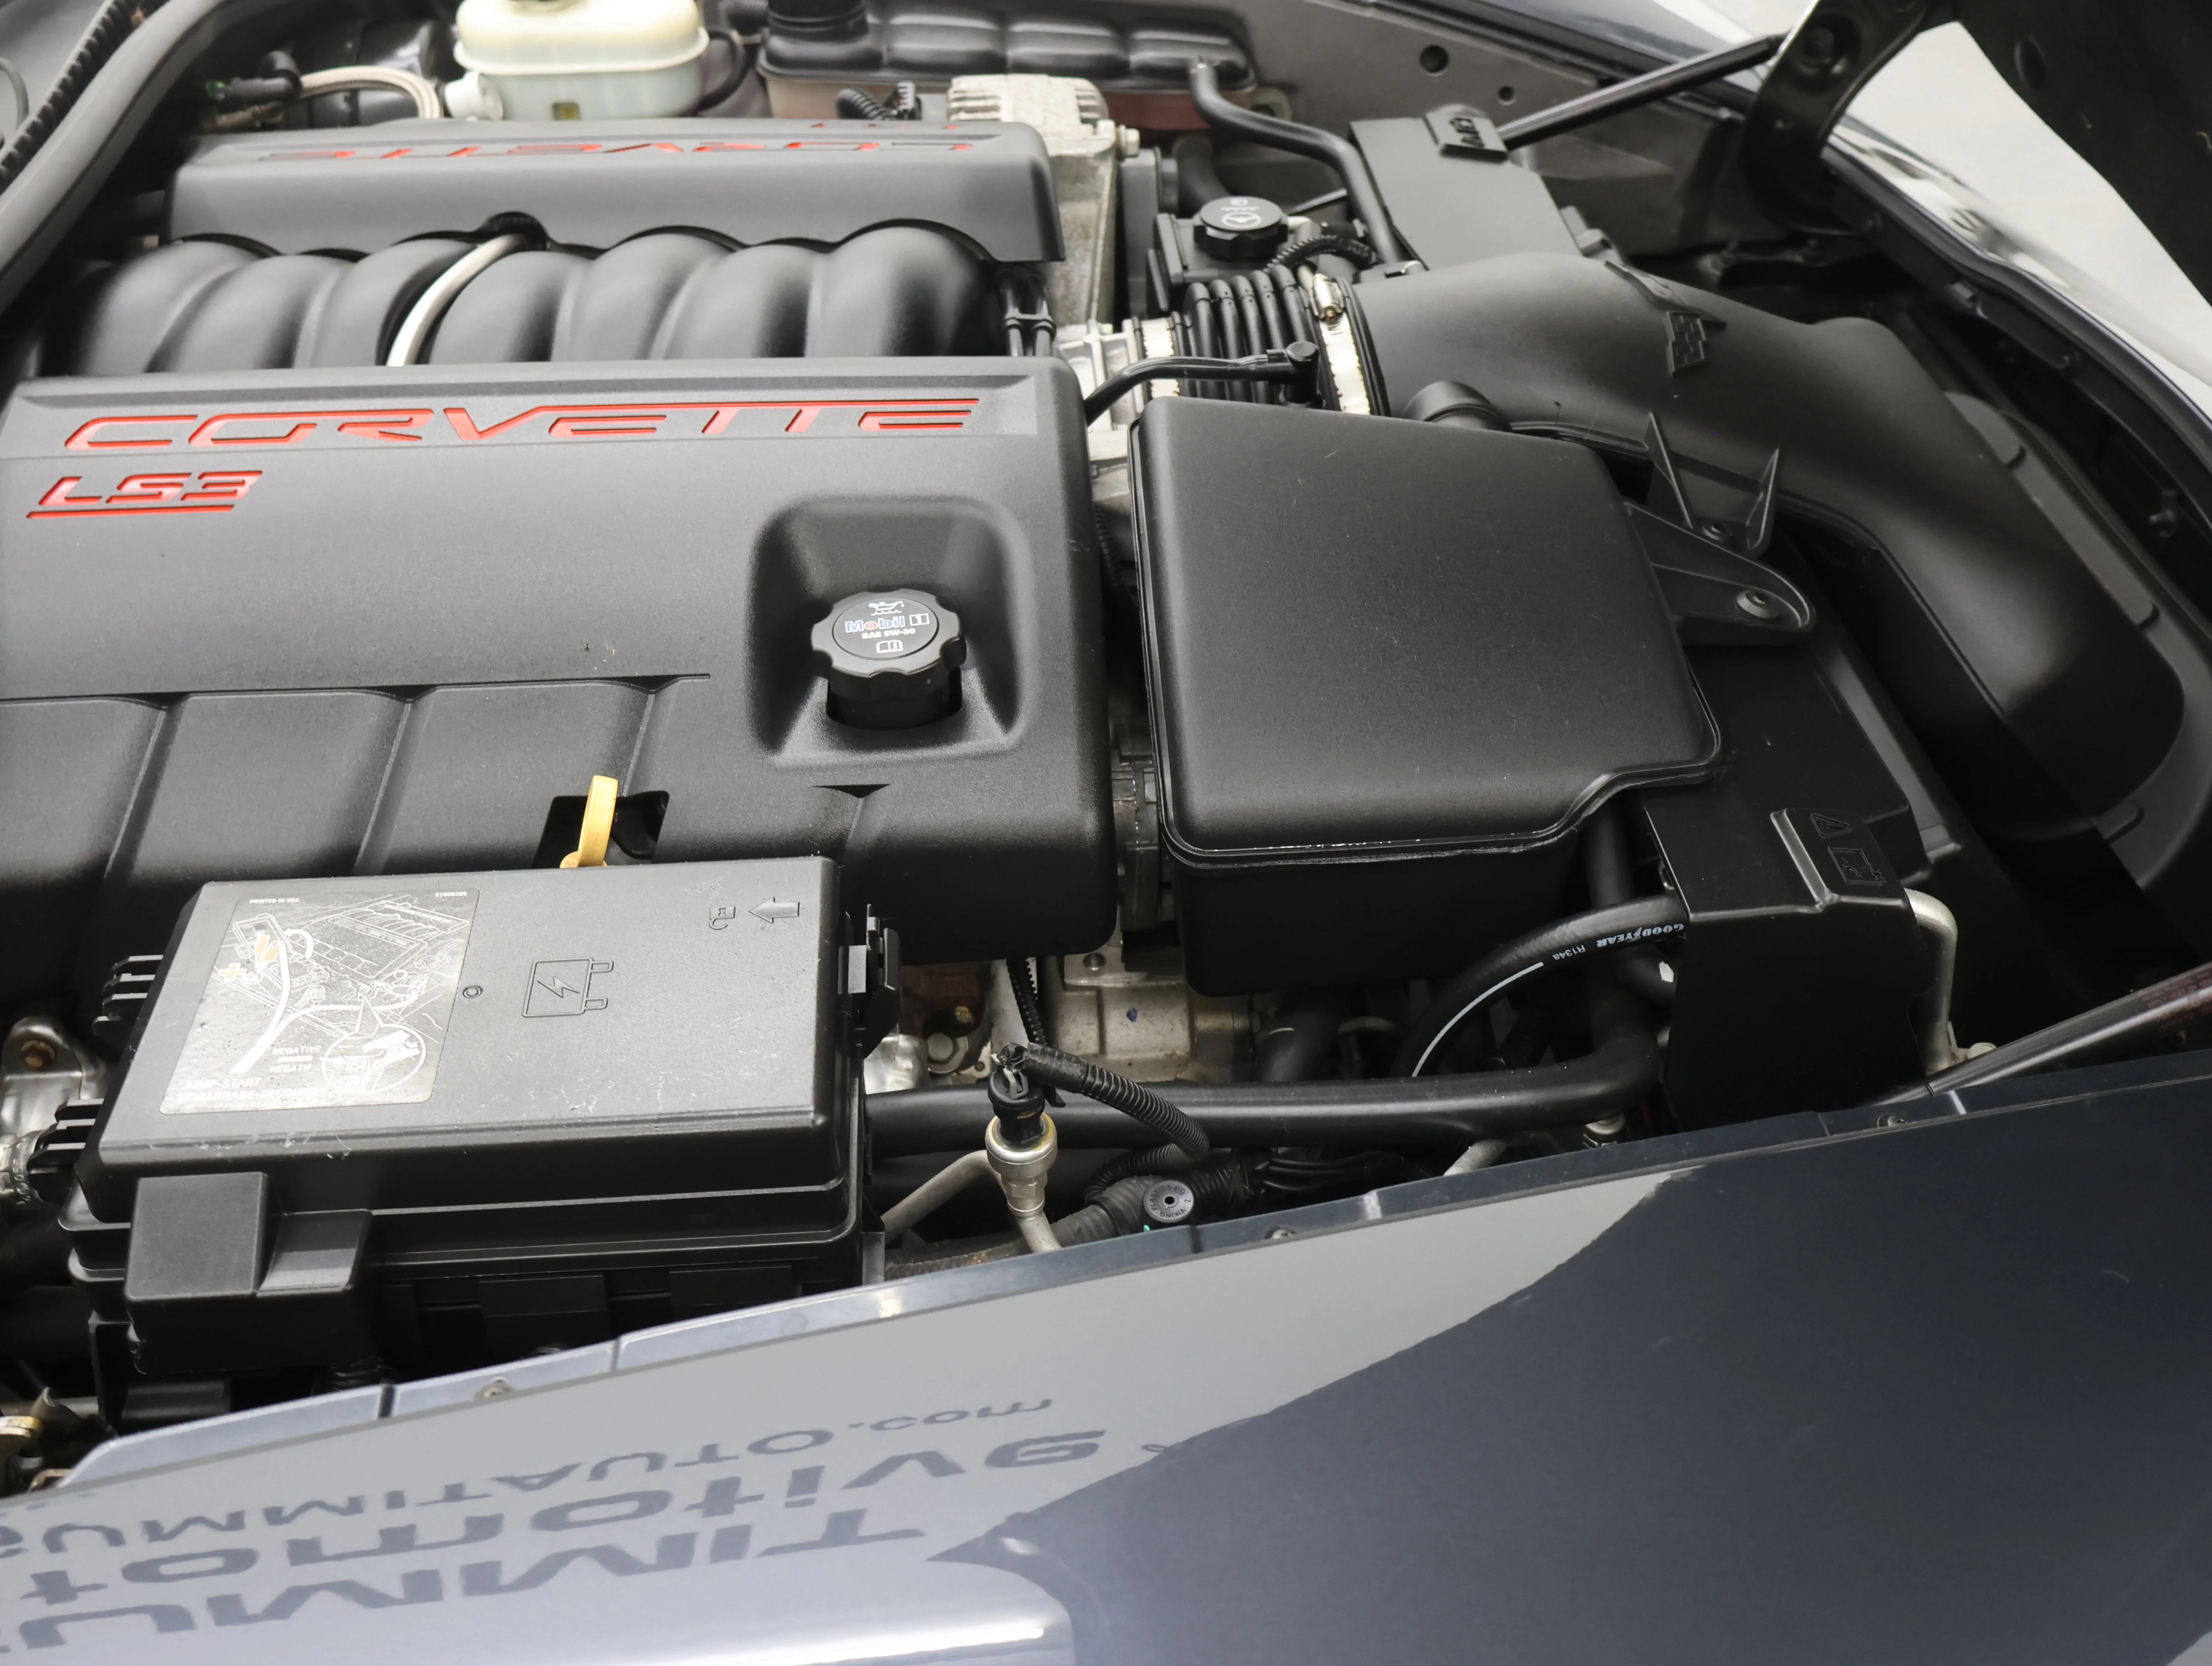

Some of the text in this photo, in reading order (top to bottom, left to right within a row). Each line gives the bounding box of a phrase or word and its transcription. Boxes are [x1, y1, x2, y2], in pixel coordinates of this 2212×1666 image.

[65, 399, 979, 450] CORVETTE
[39, 470, 263, 506] LS3
[845, 615, 906, 633] Mobil
[862, 628, 916, 639] SAE 5W-30
[1596, 924, 1684, 948] GOODYEAR
[1552, 944, 1586, 960] R134a
[272, 1045, 322, 1056] NEGATIVE
[181, 1077, 262, 1090] JUMP-START
[1159, 1208, 1186, 1218] VIKING
